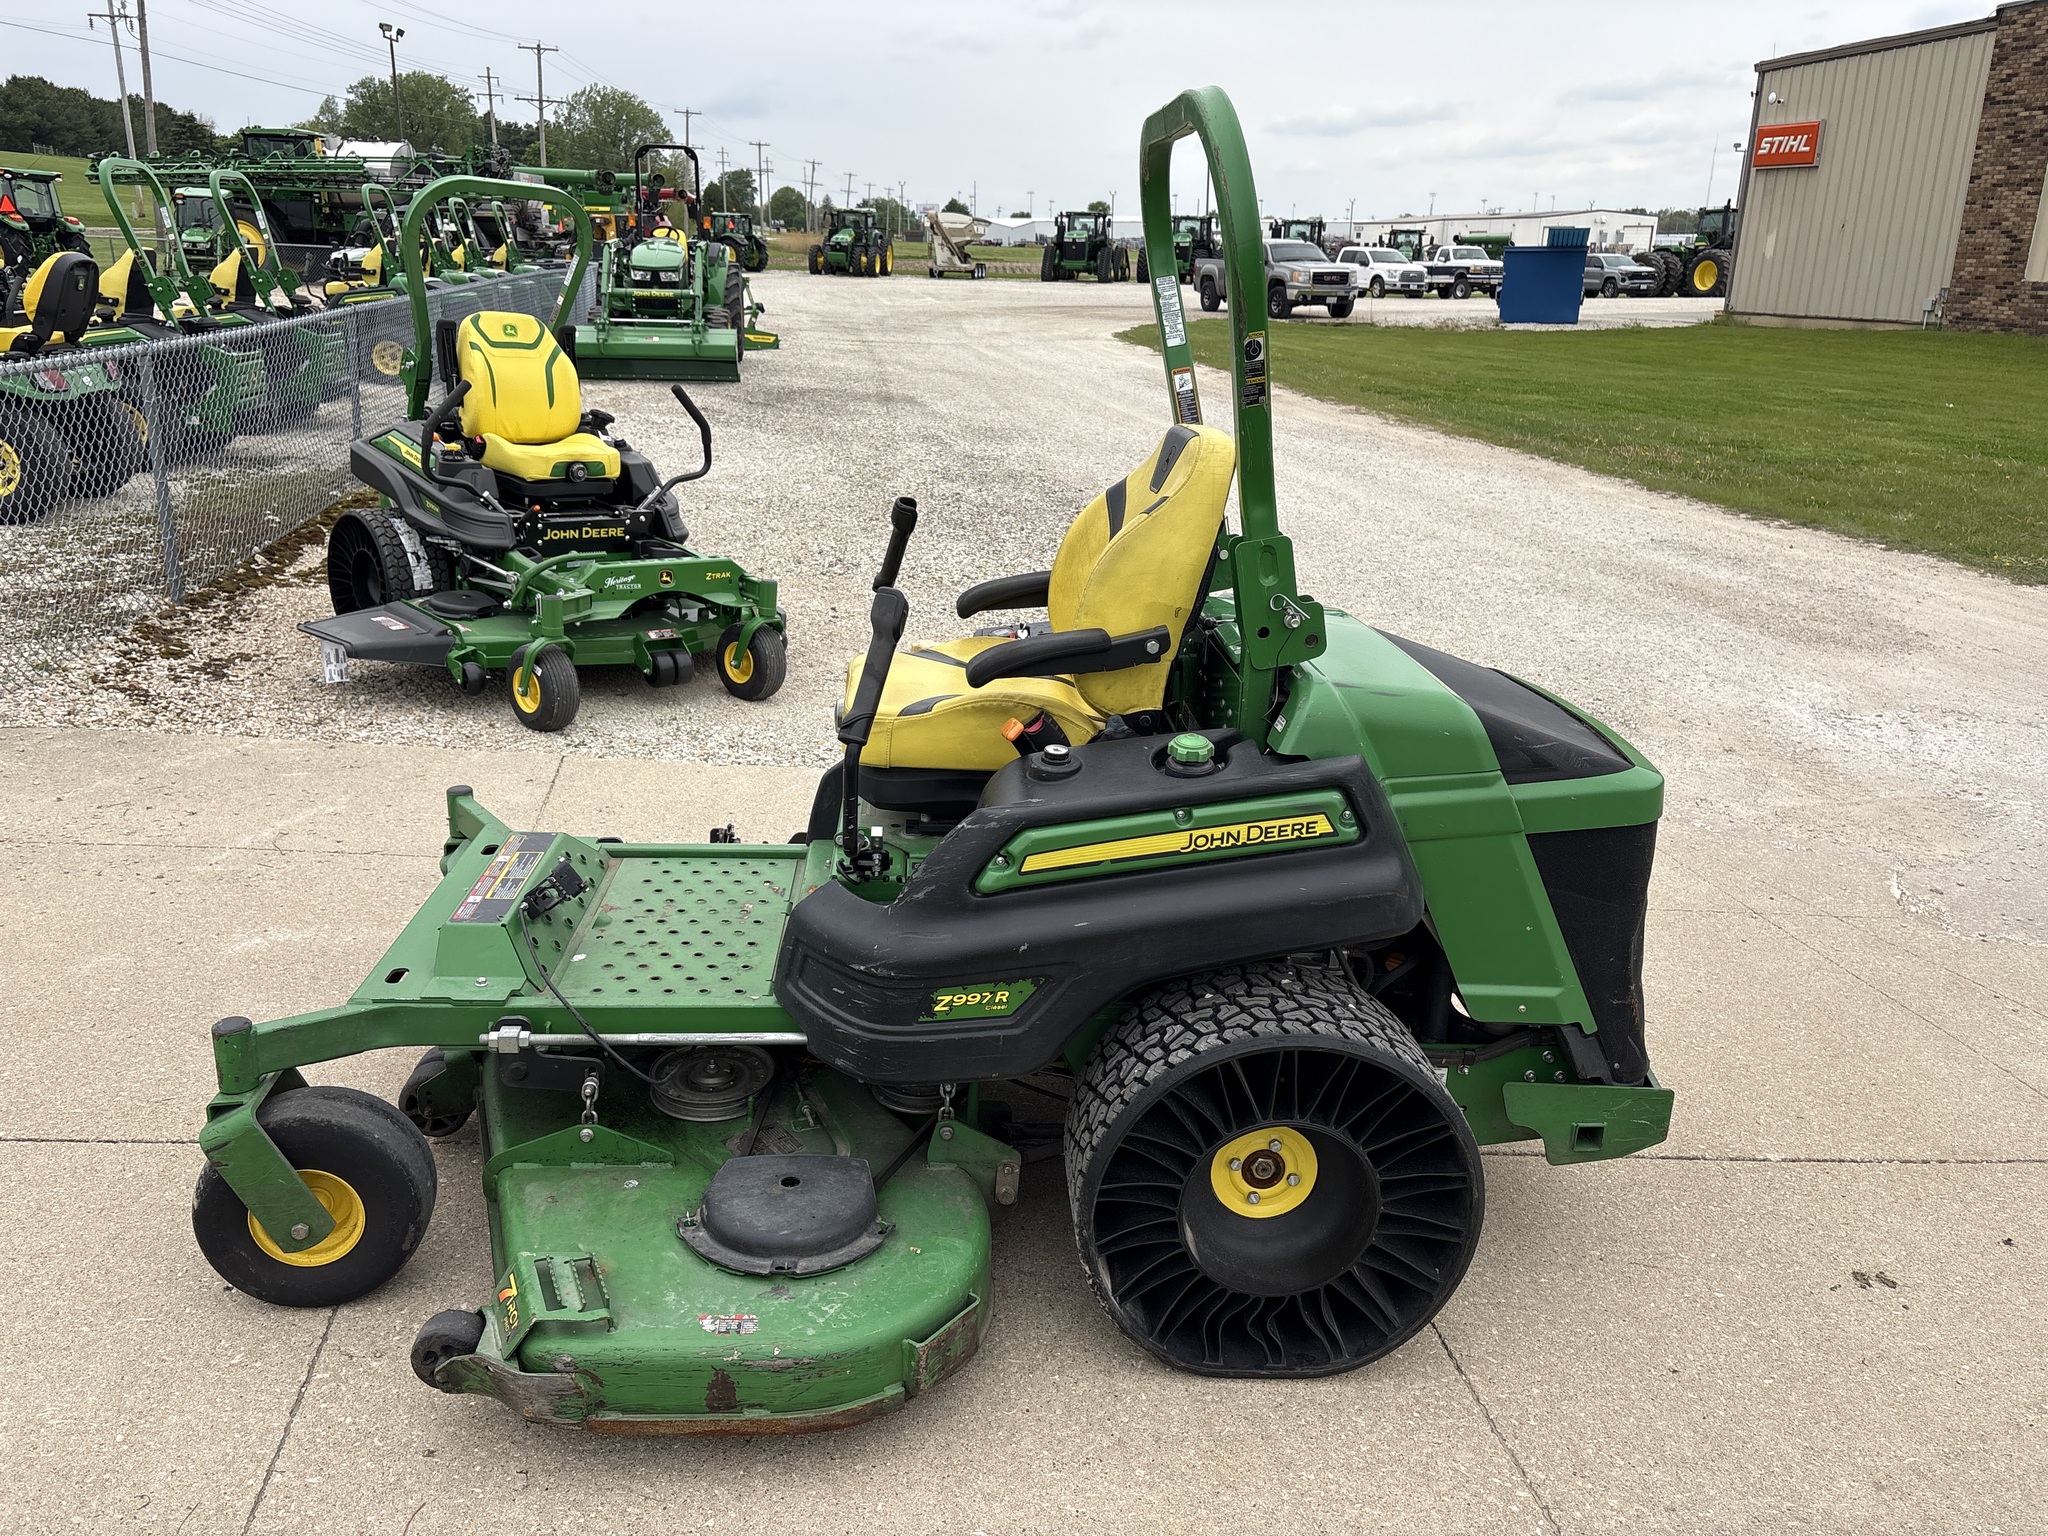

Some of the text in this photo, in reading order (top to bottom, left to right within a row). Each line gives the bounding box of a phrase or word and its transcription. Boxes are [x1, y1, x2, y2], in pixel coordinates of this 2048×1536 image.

[1757, 135, 1811, 155] STIHL
[543, 527, 625, 540] JOHN DEERE
[604, 574, 636, 589] Heritage
[706, 571, 731, 580] ZTRAK
[1180, 821, 1319, 851] JOHN DEERE
